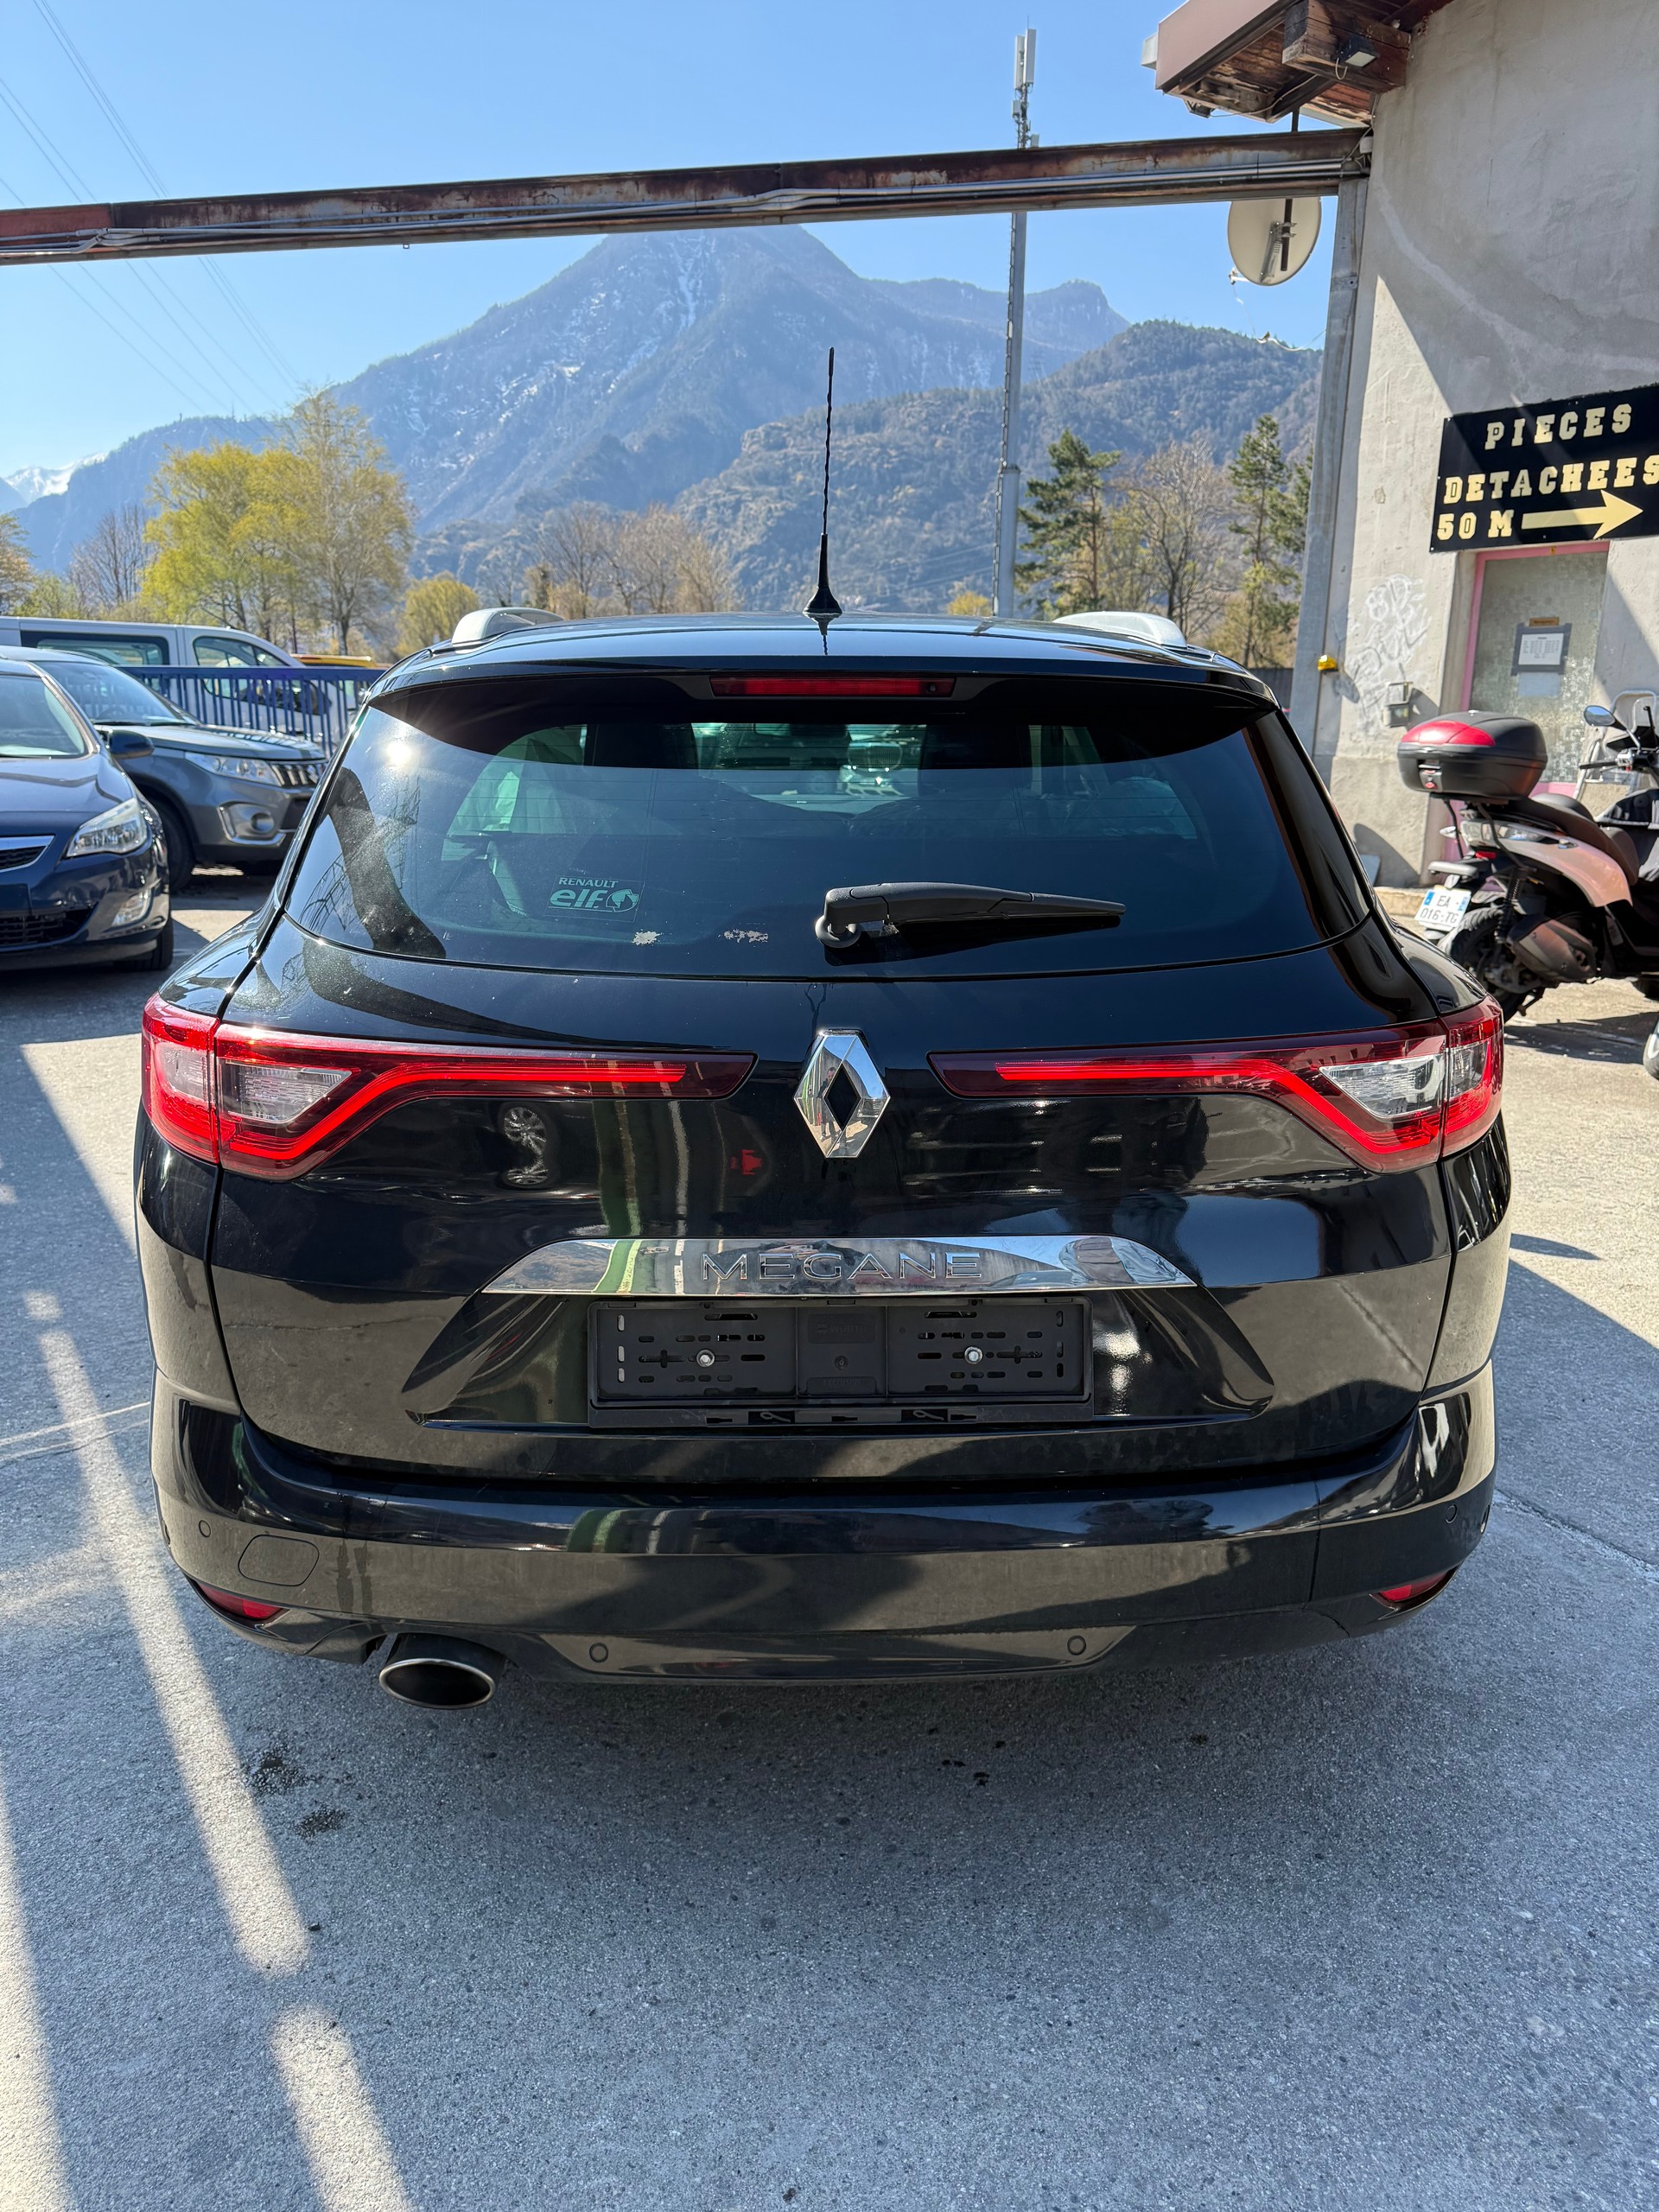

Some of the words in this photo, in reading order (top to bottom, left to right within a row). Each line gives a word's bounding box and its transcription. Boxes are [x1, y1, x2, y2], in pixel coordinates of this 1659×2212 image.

[1484, 404, 1632, 450] PIECES
[1443, 454, 1659, 505] DETACHEES
[1437, 512, 1477, 541] 50
[1488, 510, 1515, 537] M
[558, 877, 619, 888] RENAULT
[550, 888, 607, 908] elf
[702, 1253, 982, 1281] MEGANE
